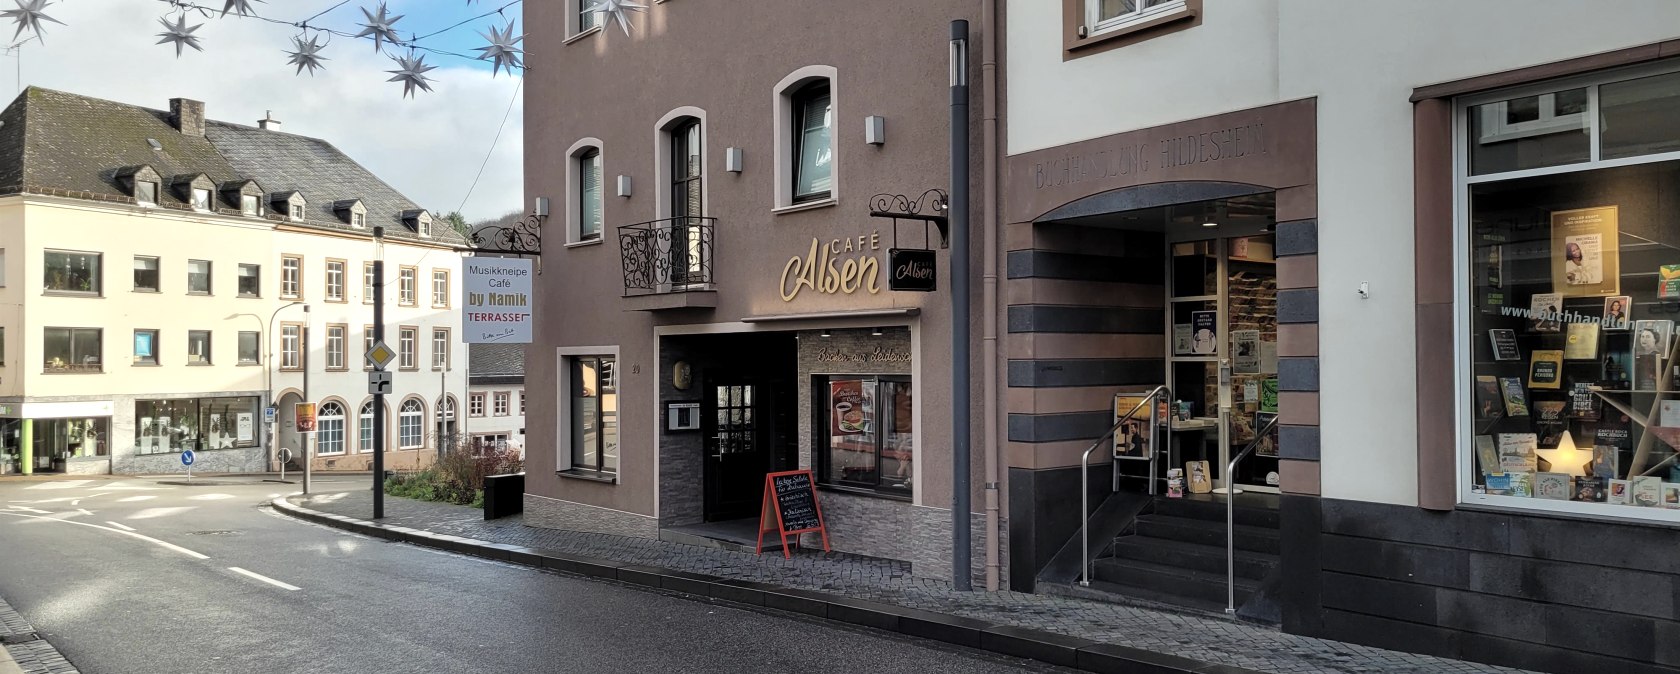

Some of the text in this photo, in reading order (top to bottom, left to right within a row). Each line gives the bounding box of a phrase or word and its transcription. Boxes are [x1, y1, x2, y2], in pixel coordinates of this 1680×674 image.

[1035, 123, 1268, 190] BUCHHANDLUNG HILDESHEIM
[832, 230, 880, 254] CAFÉ
[469, 266, 528, 277] Musikkneipe
[780, 237, 880, 302] Alsen
[896, 260, 933, 280] Alsen
[488, 278, 511, 288] Café
[469, 292, 527, 306] by Namik
[468, 312, 520, 322] TERRASSE
[817, 347, 849, 362] Backen
[852, 353, 867, 362] aus
